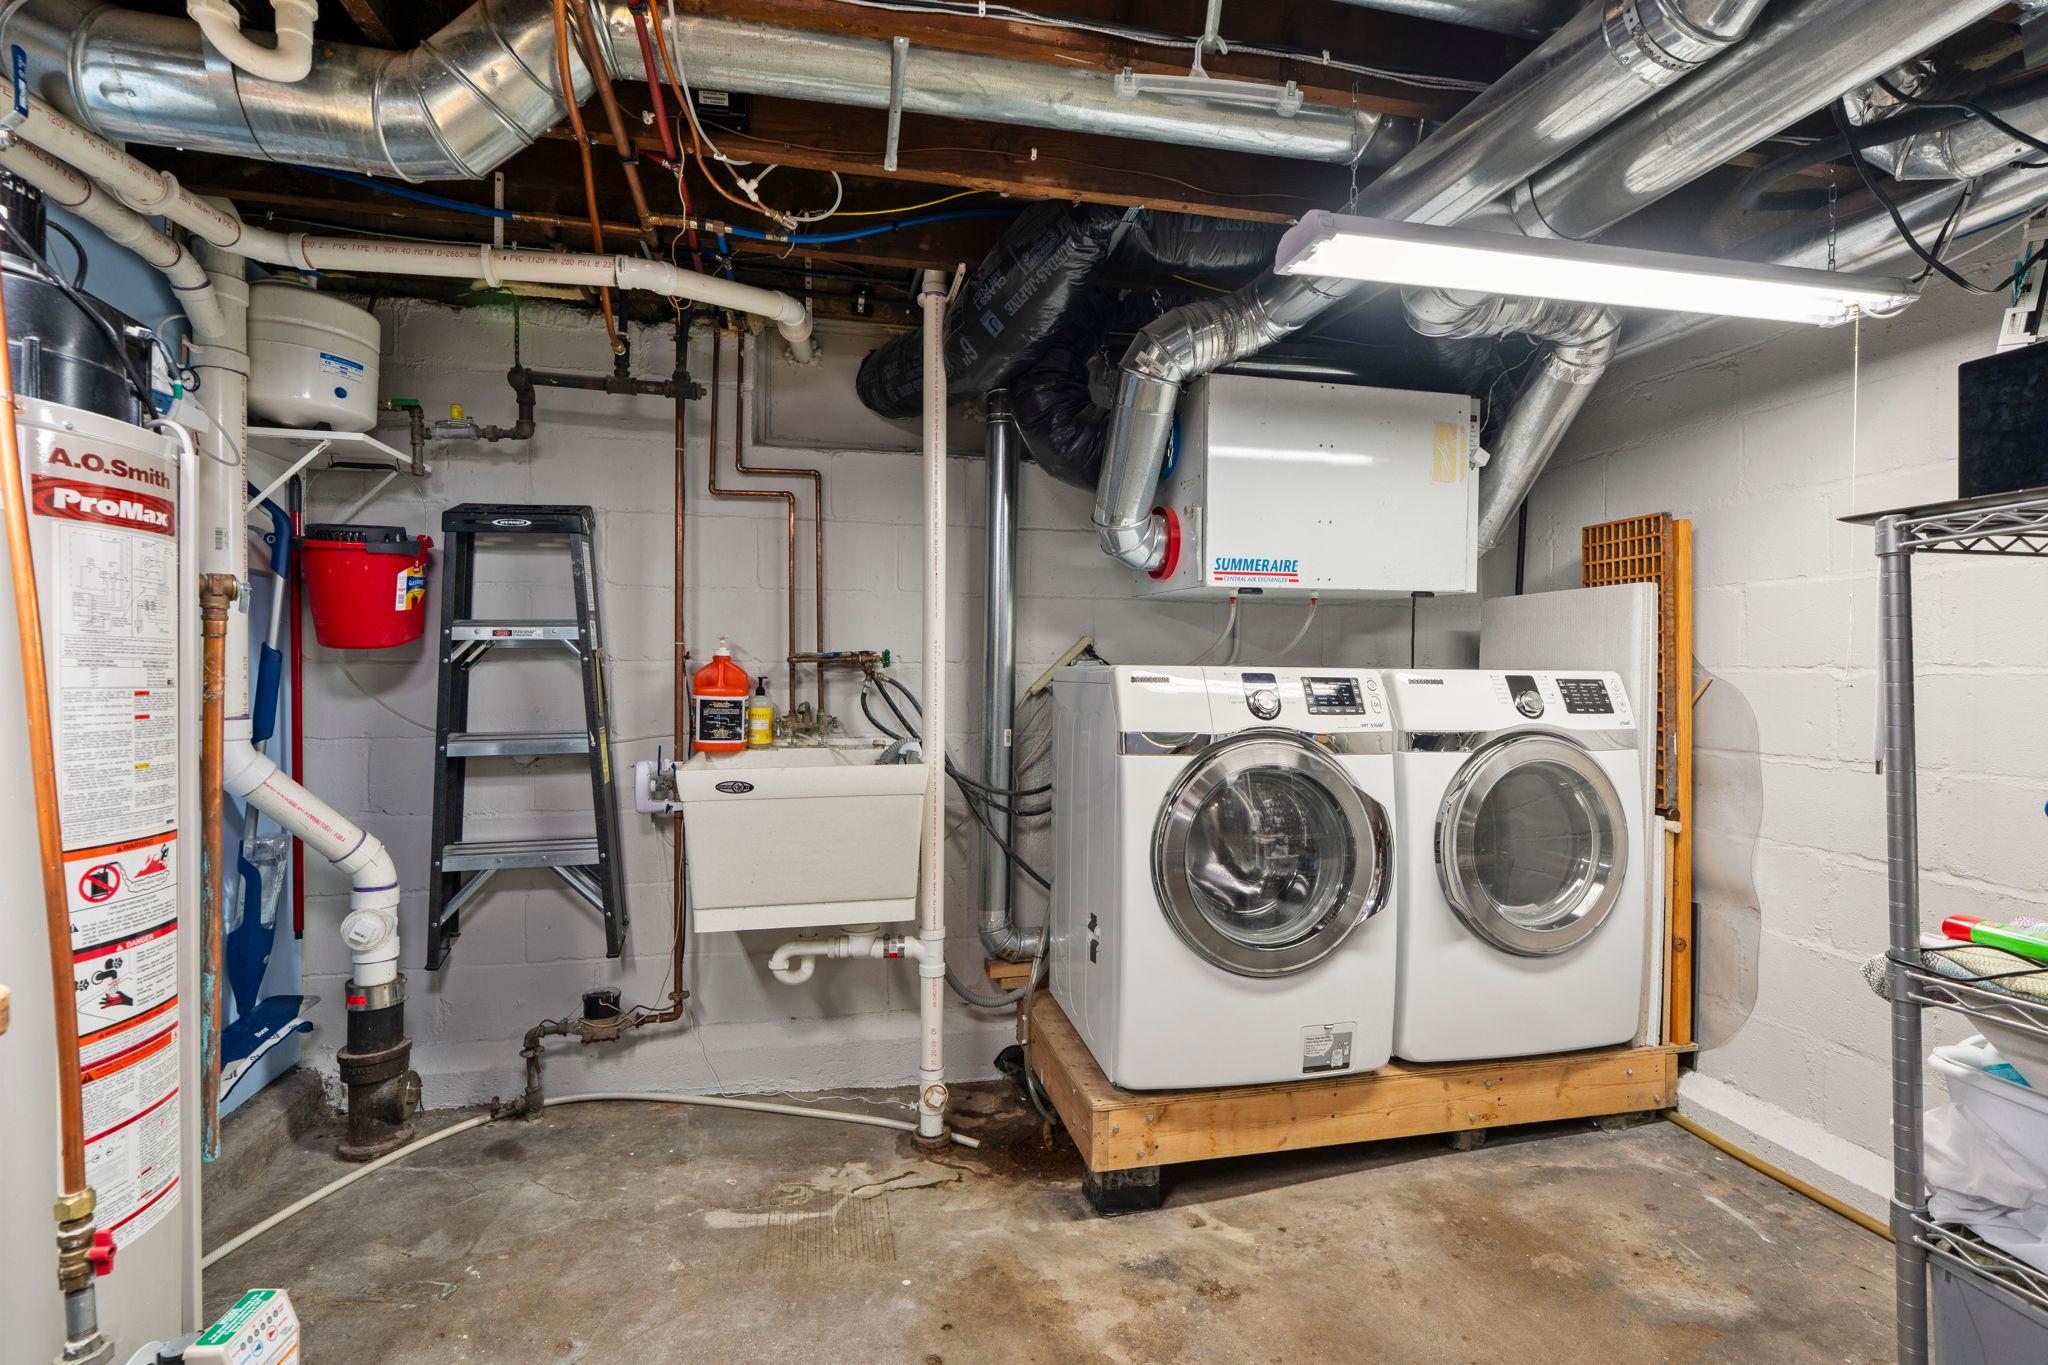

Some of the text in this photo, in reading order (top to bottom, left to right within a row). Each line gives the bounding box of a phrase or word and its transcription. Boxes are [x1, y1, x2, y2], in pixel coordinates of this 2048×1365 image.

[352, 244, 369, 252] TYPE
[383, 246, 398, 254] SCH
[414, 248, 433, 256] ASTM
[527, 256, 545, 264] 1120
[577, 259, 591, 267] PSI
[54, 487, 168, 526] ProMax
[126, 934, 154, 948] DANGER
[254, 1027, 269, 1038] Bona
